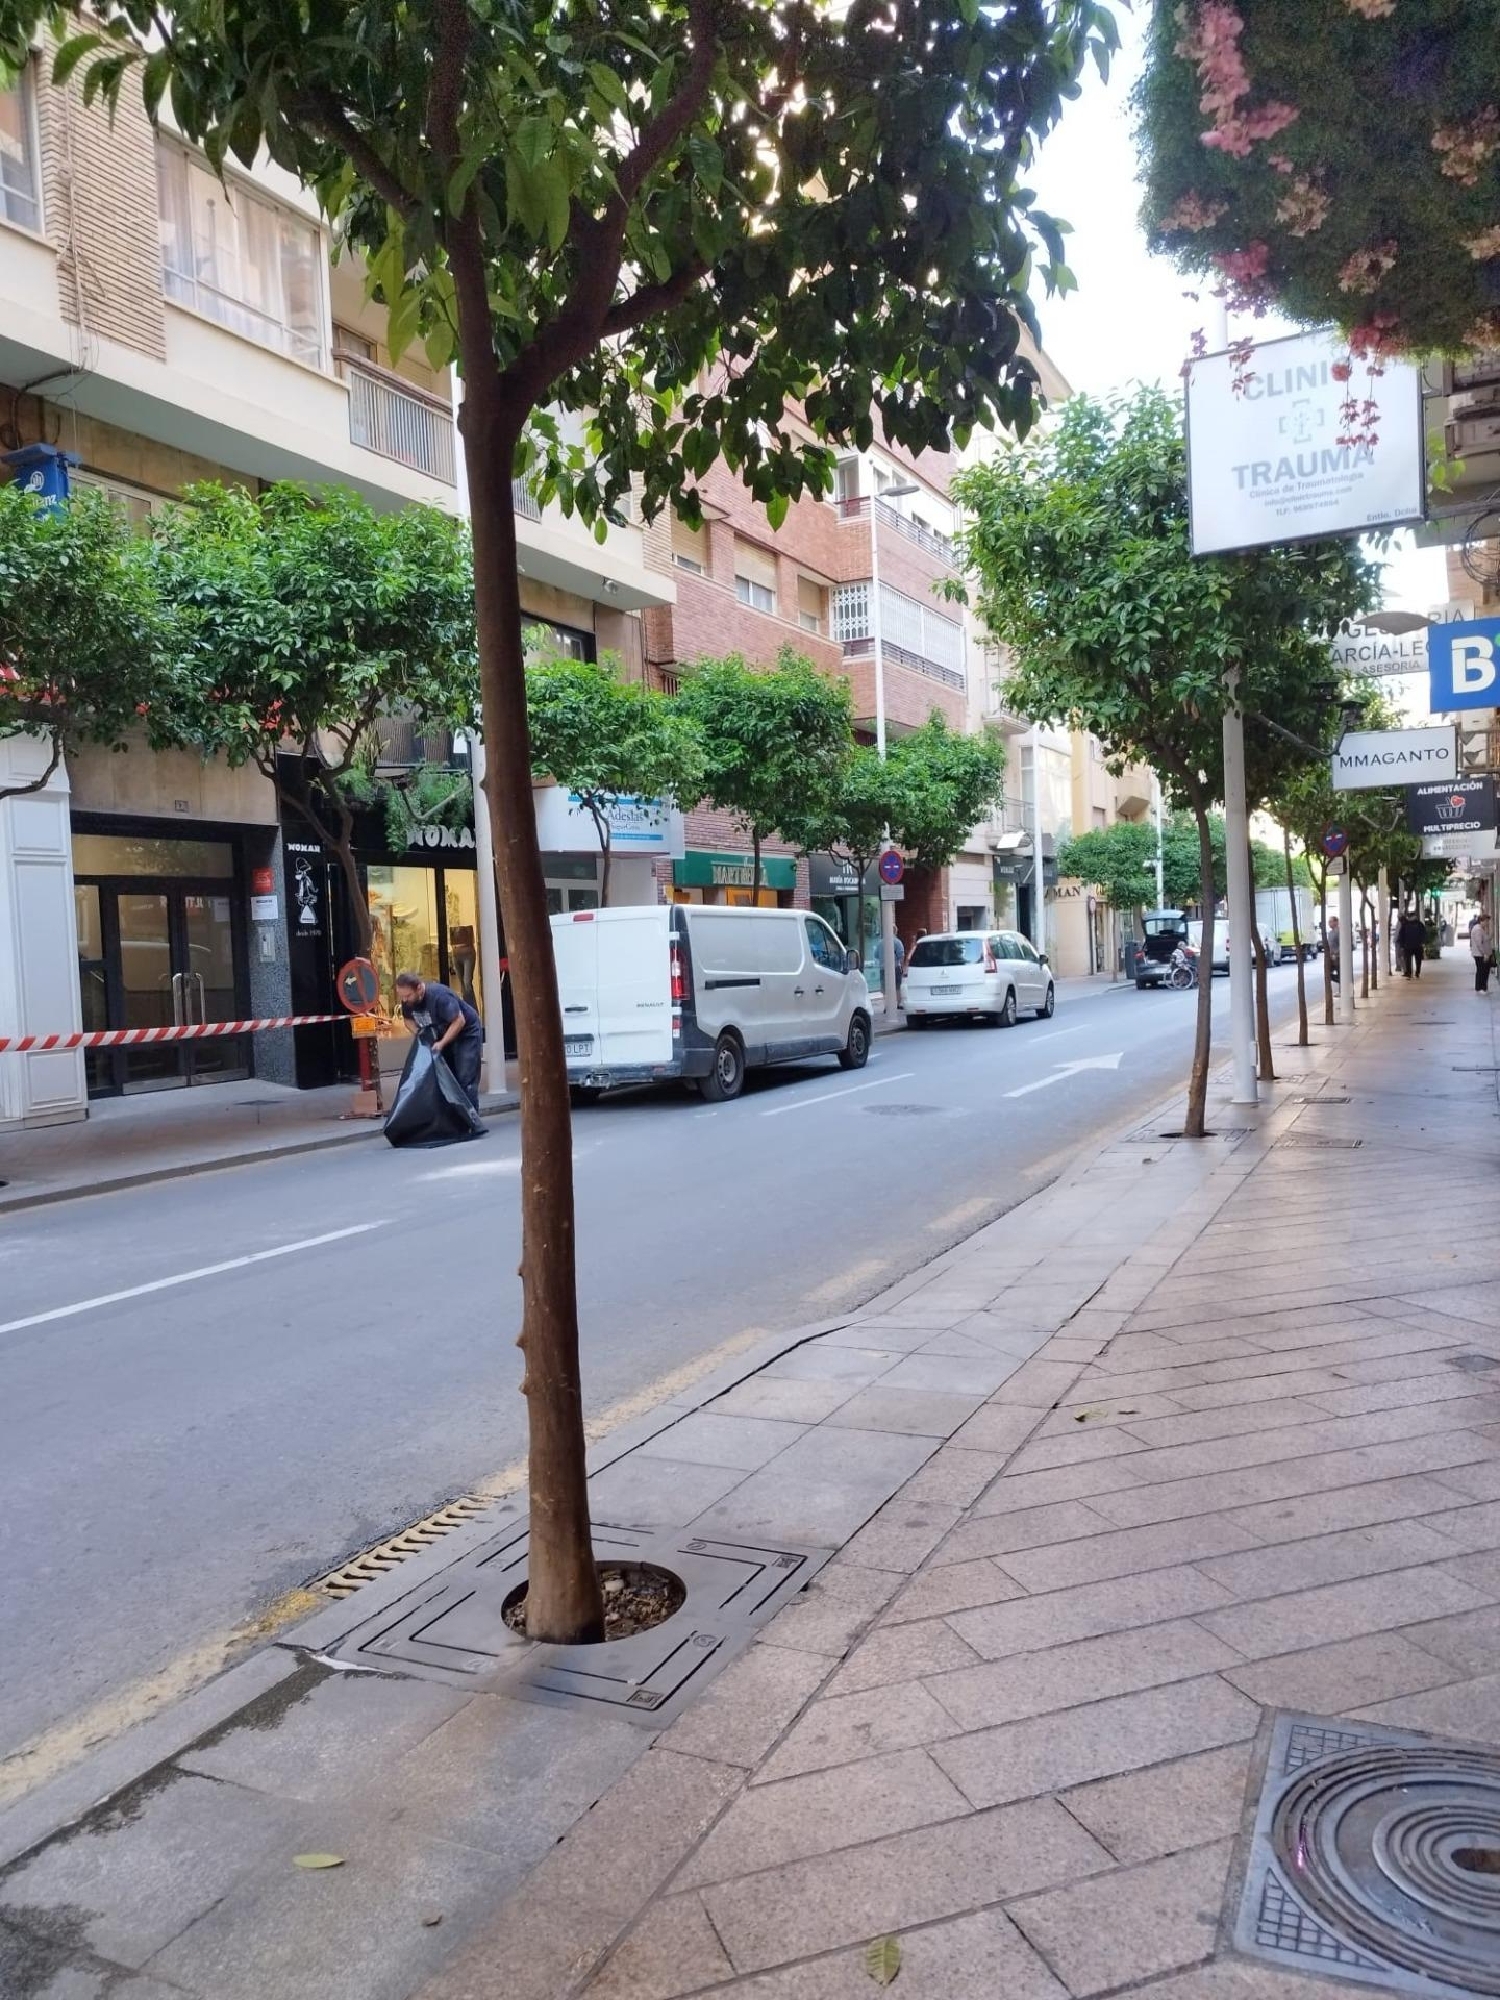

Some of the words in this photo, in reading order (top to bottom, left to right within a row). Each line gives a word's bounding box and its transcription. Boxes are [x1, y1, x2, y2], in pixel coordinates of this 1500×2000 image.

[1244, 360, 1329, 400] CLINI
[1231, 442, 1375, 490] TRAUMA
[1331, 640, 1428, 664] ARCÍA-LE
[1339, 748, 1449, 769] MMAGANTO
[1417, 781, 1483, 795] ALIMENTACIÓN
[606, 806, 644, 821] Adeslas
[1423, 821, 1481, 833] MULTIPRECIO
